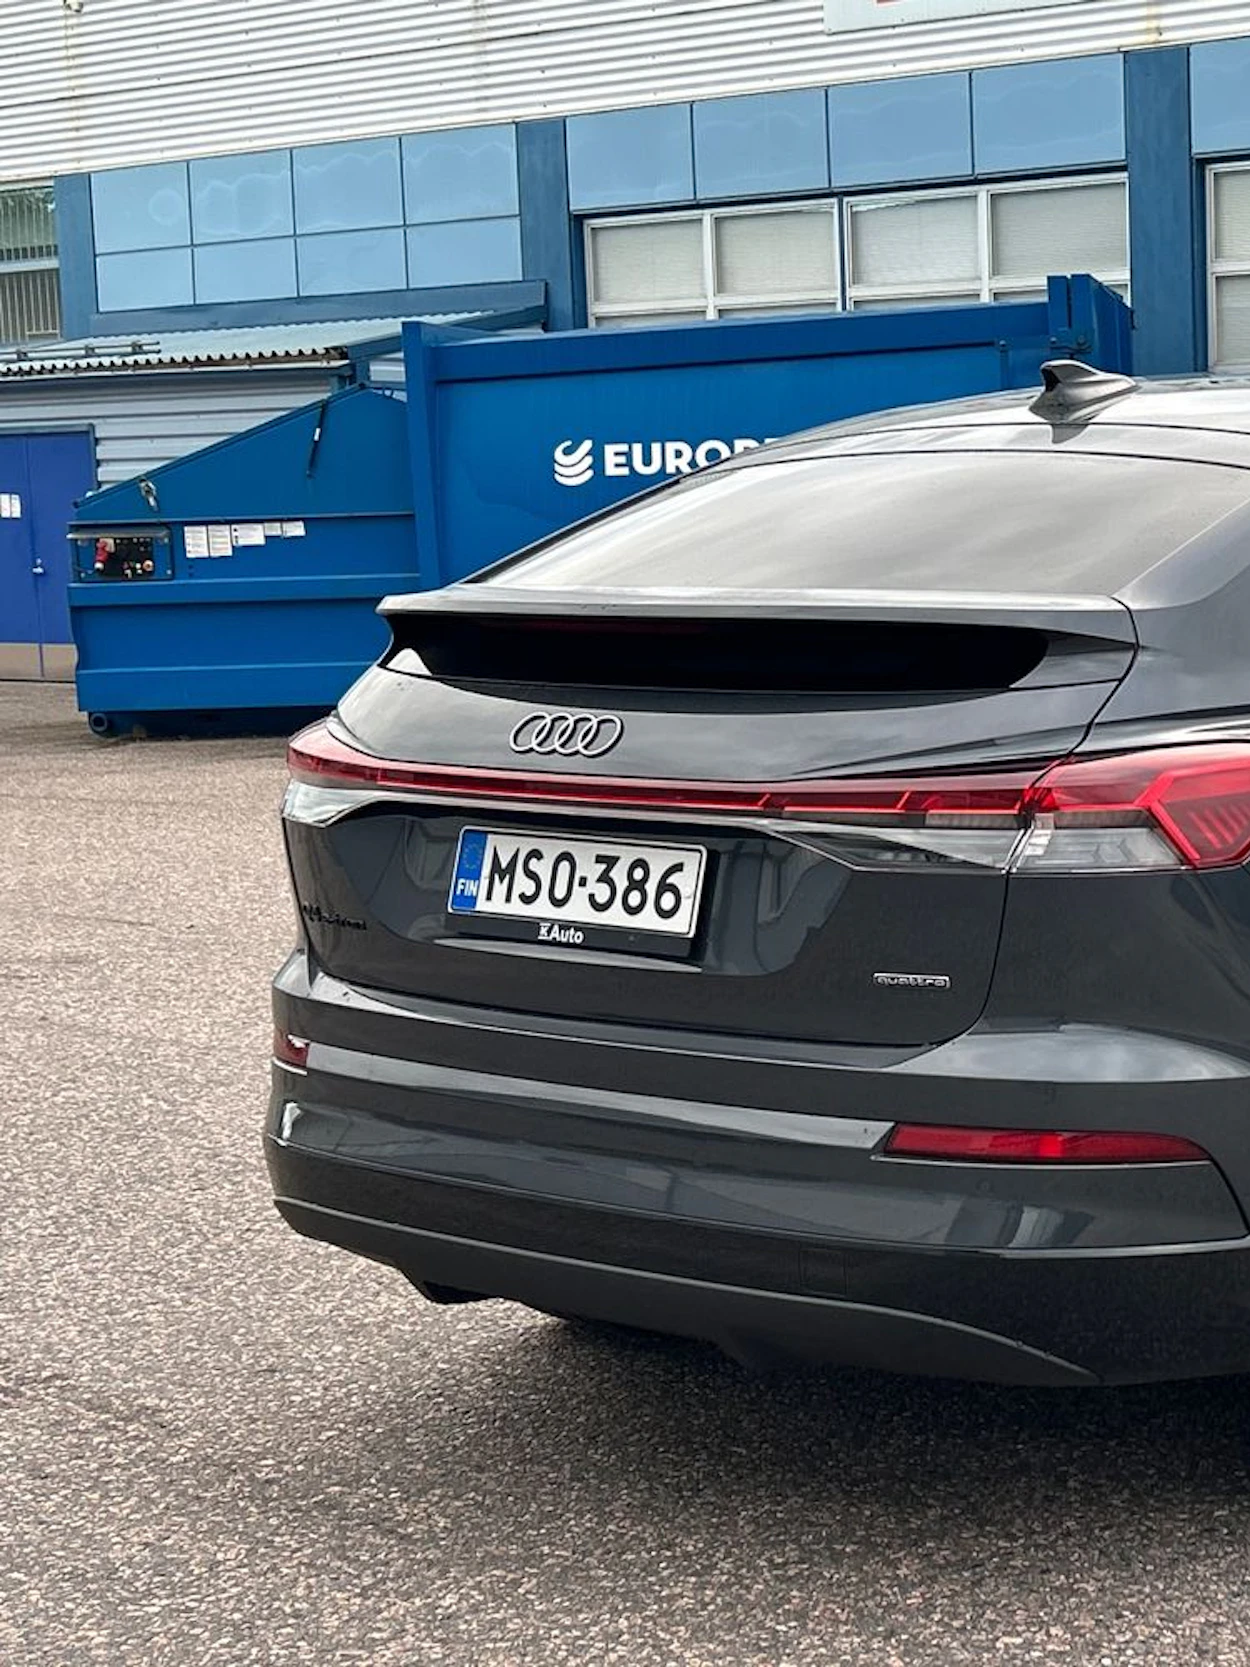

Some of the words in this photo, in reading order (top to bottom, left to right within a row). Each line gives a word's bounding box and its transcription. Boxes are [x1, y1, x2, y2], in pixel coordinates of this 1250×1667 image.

[456, 877, 480, 897] FIN
[485, 846, 685, 920] MSO-386
[875, 974, 949, 988] quattro
